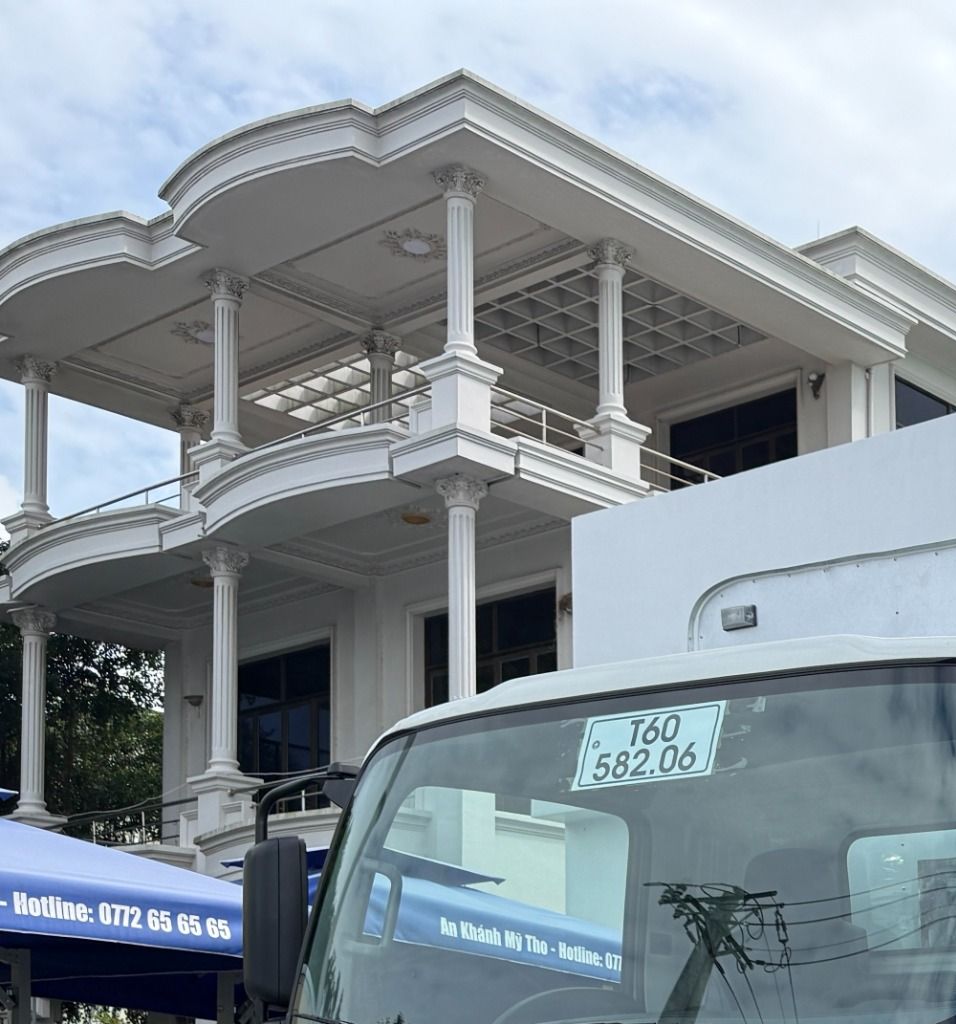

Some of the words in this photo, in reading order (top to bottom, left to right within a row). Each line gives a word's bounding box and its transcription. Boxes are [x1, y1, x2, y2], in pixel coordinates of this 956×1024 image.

[630, 714, 681, 746] T60
[592, 742, 697, 782] 582.06
[12, 891, 94, 923] Hotline:
[98, 902, 143, 929] 0772
[147, 908, 173, 933] 65
[177, 913, 202, 937] 65
[206, 917, 232, 940] 65
[440, 916, 457, 938] An
[460, 920, 502, 947] Khánh
[524, 934, 548, 956] Tho
[558, 941, 603, 967] Hotline:
